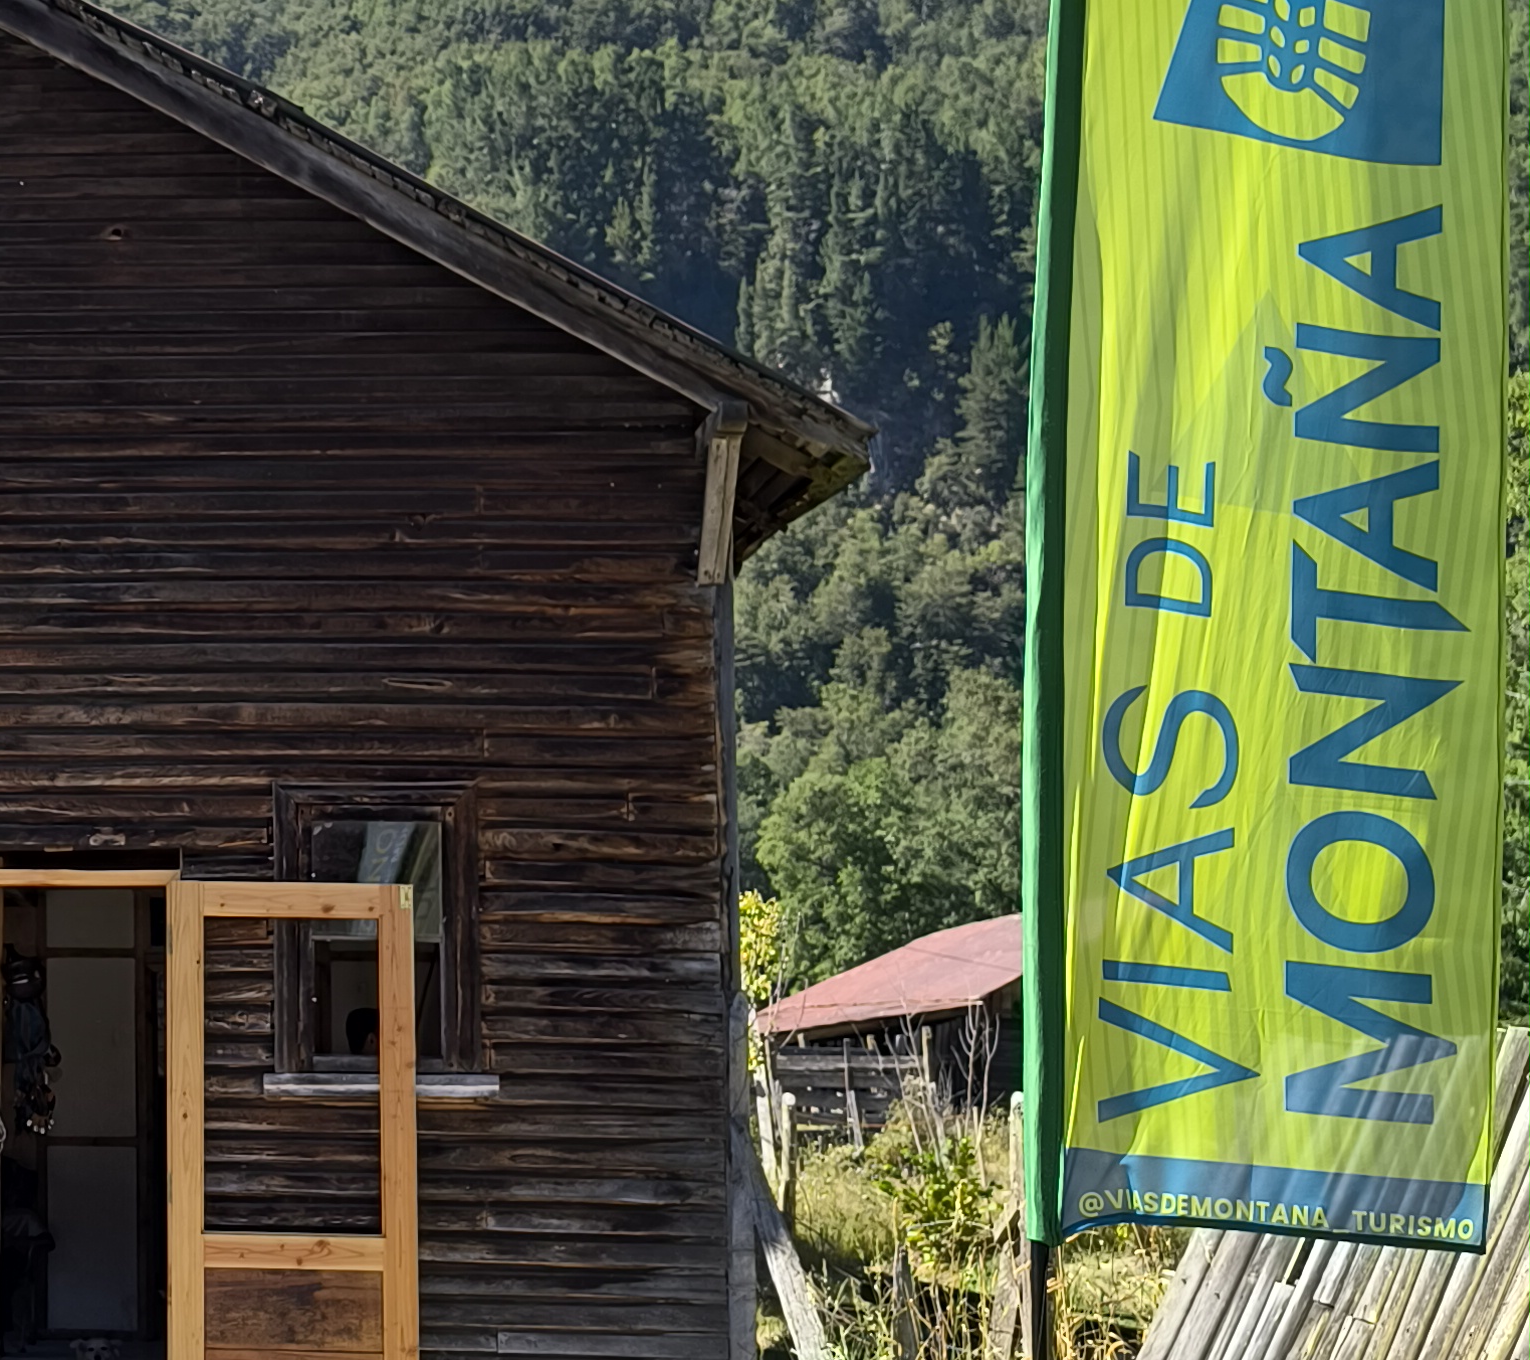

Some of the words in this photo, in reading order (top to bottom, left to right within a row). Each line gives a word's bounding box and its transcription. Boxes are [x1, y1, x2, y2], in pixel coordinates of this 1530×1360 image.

[1125, 450, 1215, 618] DE
[1262, 204, 1471, 1125] MONTAÑA
[1097, 685, 1260, 1123] VIAS
[1078, 1188, 1475, 1241] @VIASDEMONTANA_TURISMO
